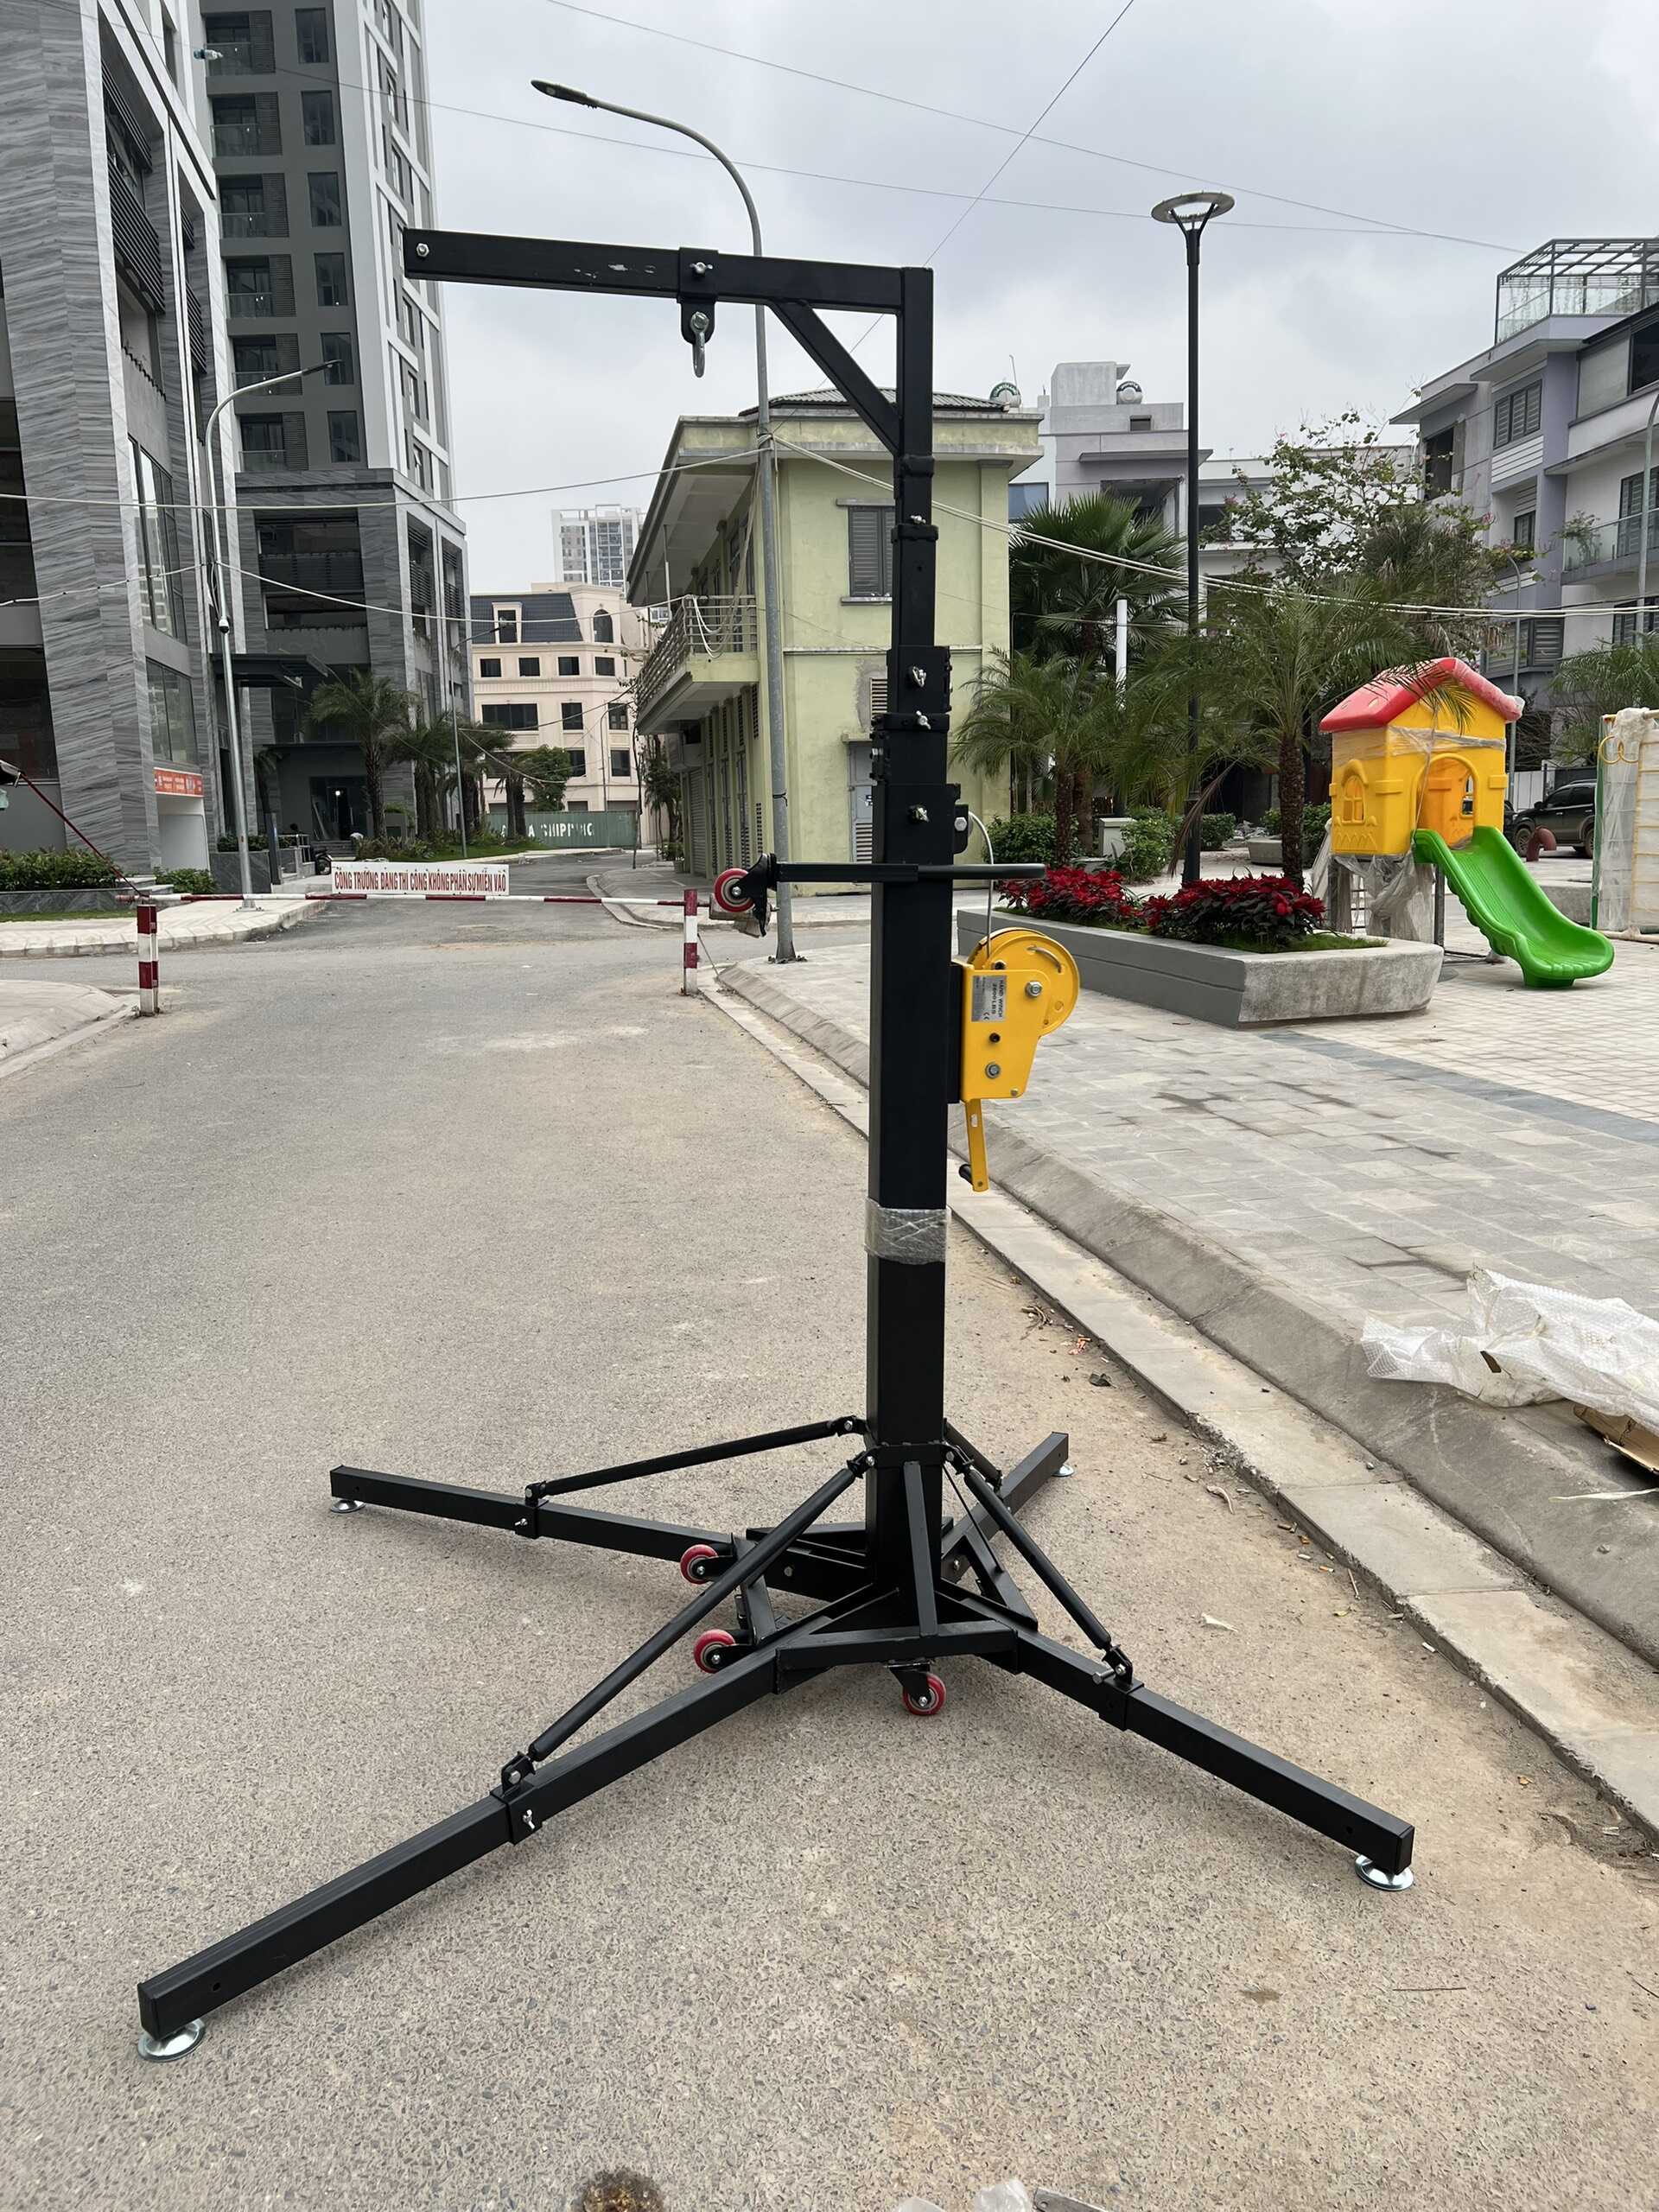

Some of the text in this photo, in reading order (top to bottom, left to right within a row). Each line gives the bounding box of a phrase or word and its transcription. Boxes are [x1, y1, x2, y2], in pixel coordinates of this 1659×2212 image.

[334, 868, 353, 889] CÔNG
[410, 868, 428, 891] CÔNG
[428, 868, 449, 892] KHÔNG
